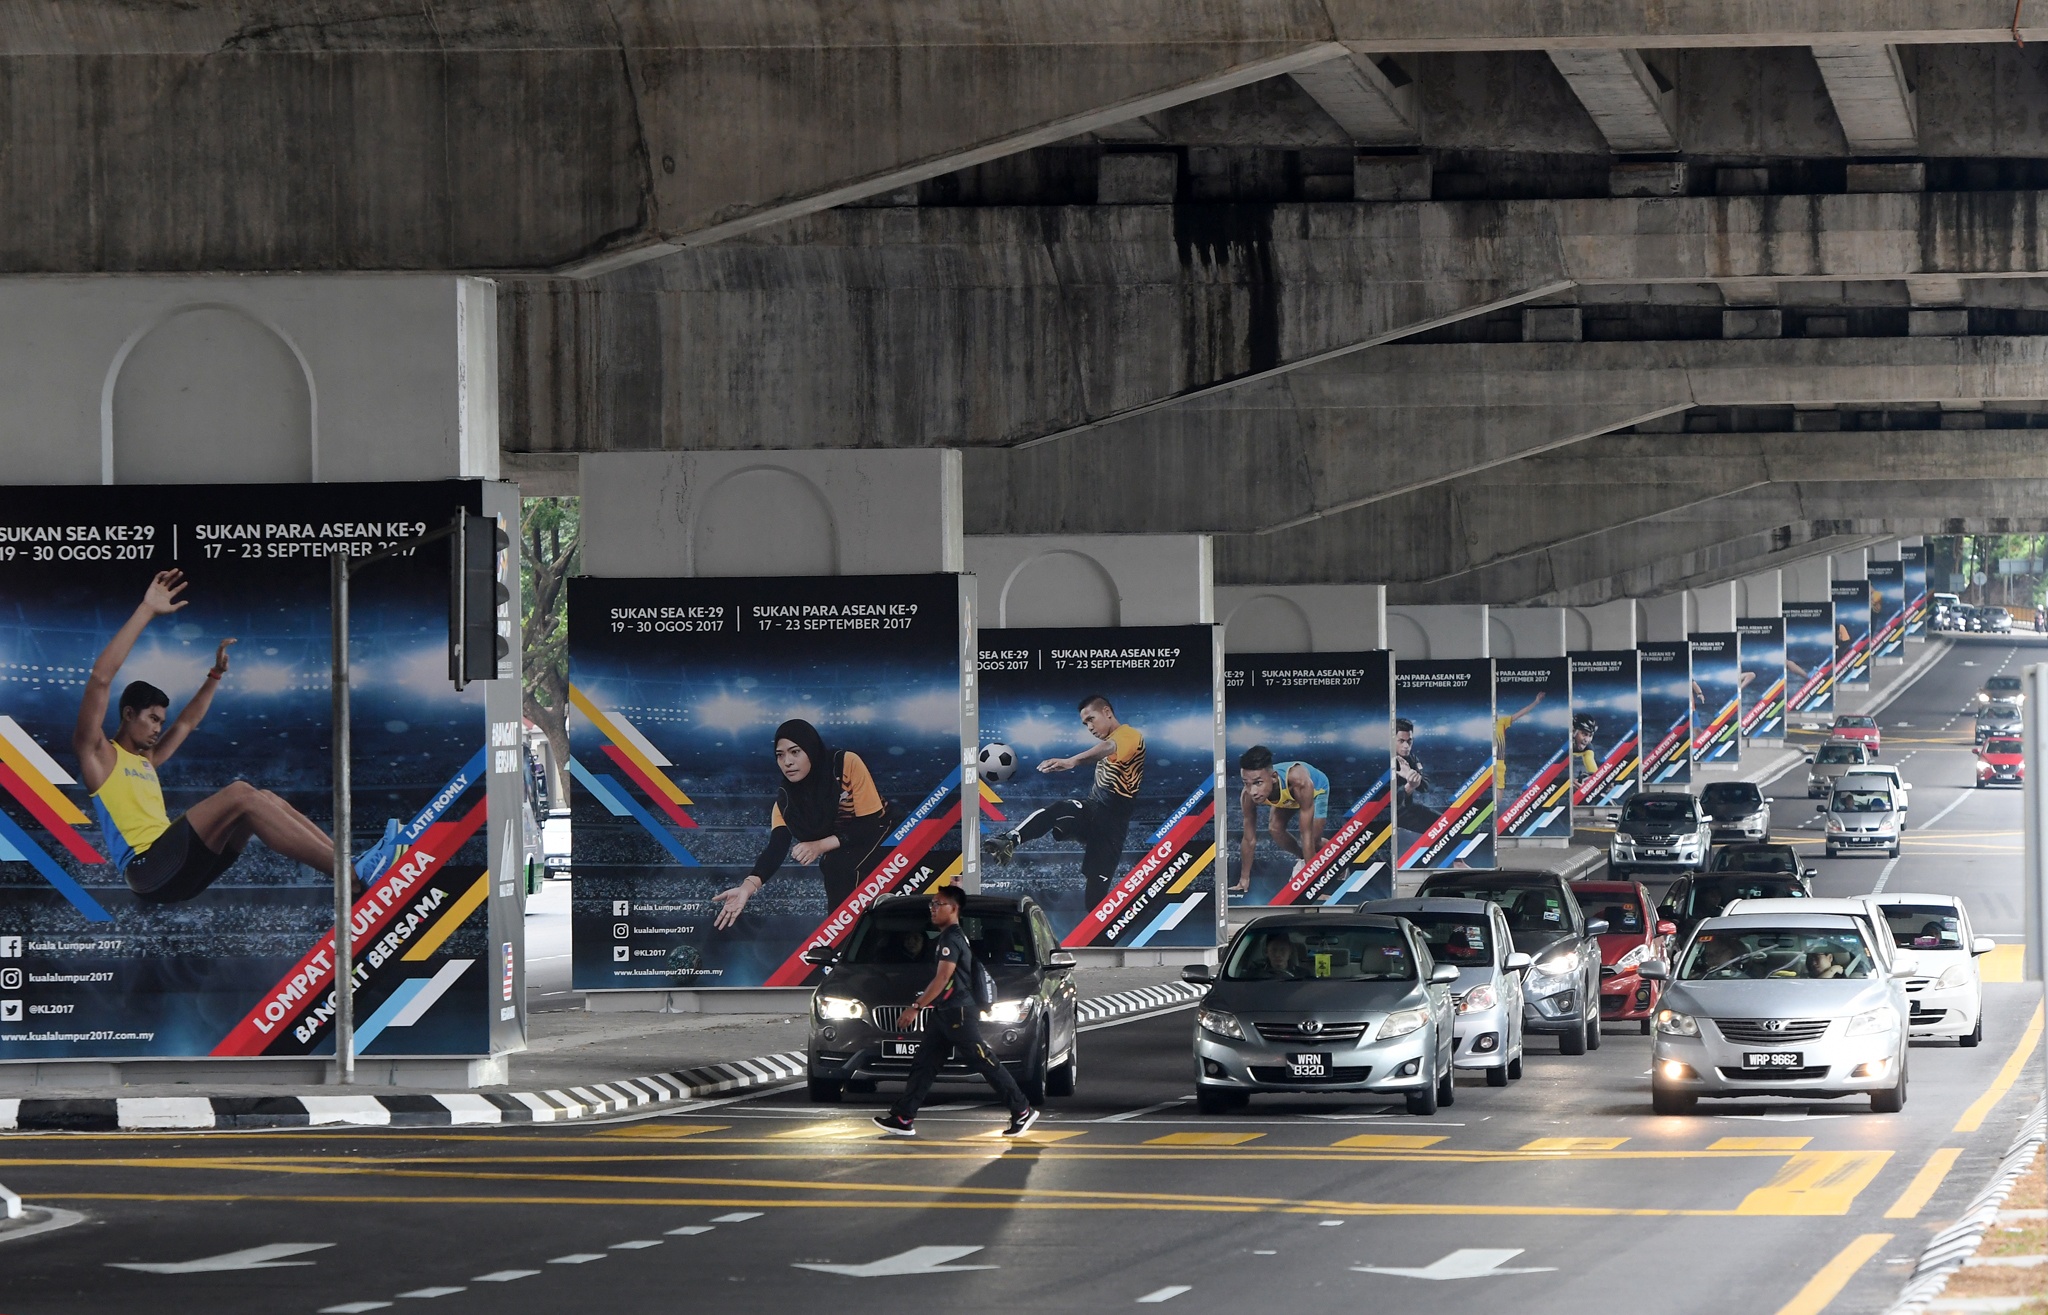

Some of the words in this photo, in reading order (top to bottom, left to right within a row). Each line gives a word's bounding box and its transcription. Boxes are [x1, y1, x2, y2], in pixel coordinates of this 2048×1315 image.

[0, 526, 61, 542] SUKAN
[66, 526, 101, 541] SEA
[105, 525, 155, 541] KE-29
[195, 524, 261, 539] SUKAN
[265, 523, 315, 539] PARA
[319, 523, 382, 538] ASEAN
[386, 522, 426, 537] KE-9
[32, 546, 53, 561] 30
[58, 545, 112, 560] OGOS
[116, 545, 155, 560] 2017
[204, 544, 222, 558] 17
[241, 543, 262, 558] 23
[267, 542, 372, 558] SEPTEMBER
[611, 608, 657, 619] SUKAN
[660, 607, 685, 618] SEA
[688, 607, 724, 618] KE-29
[753, 606, 799, 617] SUKAN
[803, 605, 839, 616] PARA
[841, 604, 886, 616] ASEAN
[889, 604, 918, 615] KE-9
[611, 622, 624, 632] 19
[637, 621, 651, 632] 30
[655, 621, 693, 632] OGOS
[696, 620, 724, 632] 2017
[759, 620, 772, 631] 17
[785, 619, 800, 630] 23
[803, 618, 880, 630] SEPTEMBER
[883, 618, 912, 629] 2017
[979, 651, 998, 659] SEA
[1001, 650, 1029, 659] KE-29
[1051, 650, 1088, 659] SUKAN
[1089, 649, 1117, 658] PARA
[1120, 649, 1155, 658] ASEAN
[1157, 648, 1180, 658] KE-9
[1007, 661, 1029, 670] 2017
[1056, 660, 1066, 669] 17
[1076, 660, 1088, 669] 23
[1091, 659, 1150, 669] SEPTEMBER
[1152, 659, 1175, 668] 2017
[1261, 670, 1290, 678] SUKAN
[1316, 669, 1345, 677] ASEAN
[1346, 669, 1365, 677] KE-9
[1227, 679, 1244, 687] 2017
[1282, 678, 1292, 686] 23
[1293, 678, 1340, 686] SEPTEMBER
[1342, 678, 1361, 686] 2017
[405, 808, 435, 840] LATIF
[432, 773, 468, 814] ROMLY
[1502, 784, 1541, 823] BADMINTON
[1509, 807, 1533, 834] BANGKIT
[1531, 783, 1557, 810] BERSAMA
[894, 817, 918, 841] EMMA
[916, 786, 949, 819] FIRYANA
[1156, 806, 1188, 839] MOHAMAD
[1185, 789, 1205, 808] SOBRI
[1427, 816, 1449, 840] SILAT
[1422, 834, 1450, 865] BANGKIT
[1448, 806, 1479, 838] BERSAMA
[1291, 843, 1340, 891] OLAHRAGA
[1336, 819, 1363, 845] PARA
[1305, 863, 1340, 900] BANGKIT
[1338, 830, 1374, 867] BERSAMA
[848, 853, 909, 915] PADANG
[895, 865, 934, 897] SAMA
[1095, 889, 1129, 922] BOLA
[1124, 855, 1161, 892] SEPAK
[1157, 840, 1173, 858] CP
[1106, 894, 1149, 940] BANGKIT
[1146, 851, 1193, 899] BERSAMA
[654, 904, 681, 912] Lumpur
[366, 887, 449, 969] BERSAMA
[28, 941, 56, 950] Kuala
[58, 942, 96, 951] Lumpur
[98, 941, 121, 950] 2017
[253, 949, 332, 1034] LOMPAT
[329, 900, 384, 949] AUH
[376, 850, 436, 907] PARA
[29, 972, 113, 984] kualalumpur2017
[614, 968, 723, 977] www.kualalumpur2017.com.my
[28, 1005, 74, 1014] @KL2017
[1, 1031, 154, 1042] www.kualalumpur2017.com.my
[1297, 1054, 1321, 1065] WRN
[1749, 1054, 1770, 1066] WRP
[1771, 1053, 1798, 1066] 9662
[1294, 1065, 1325, 1076] 8320
